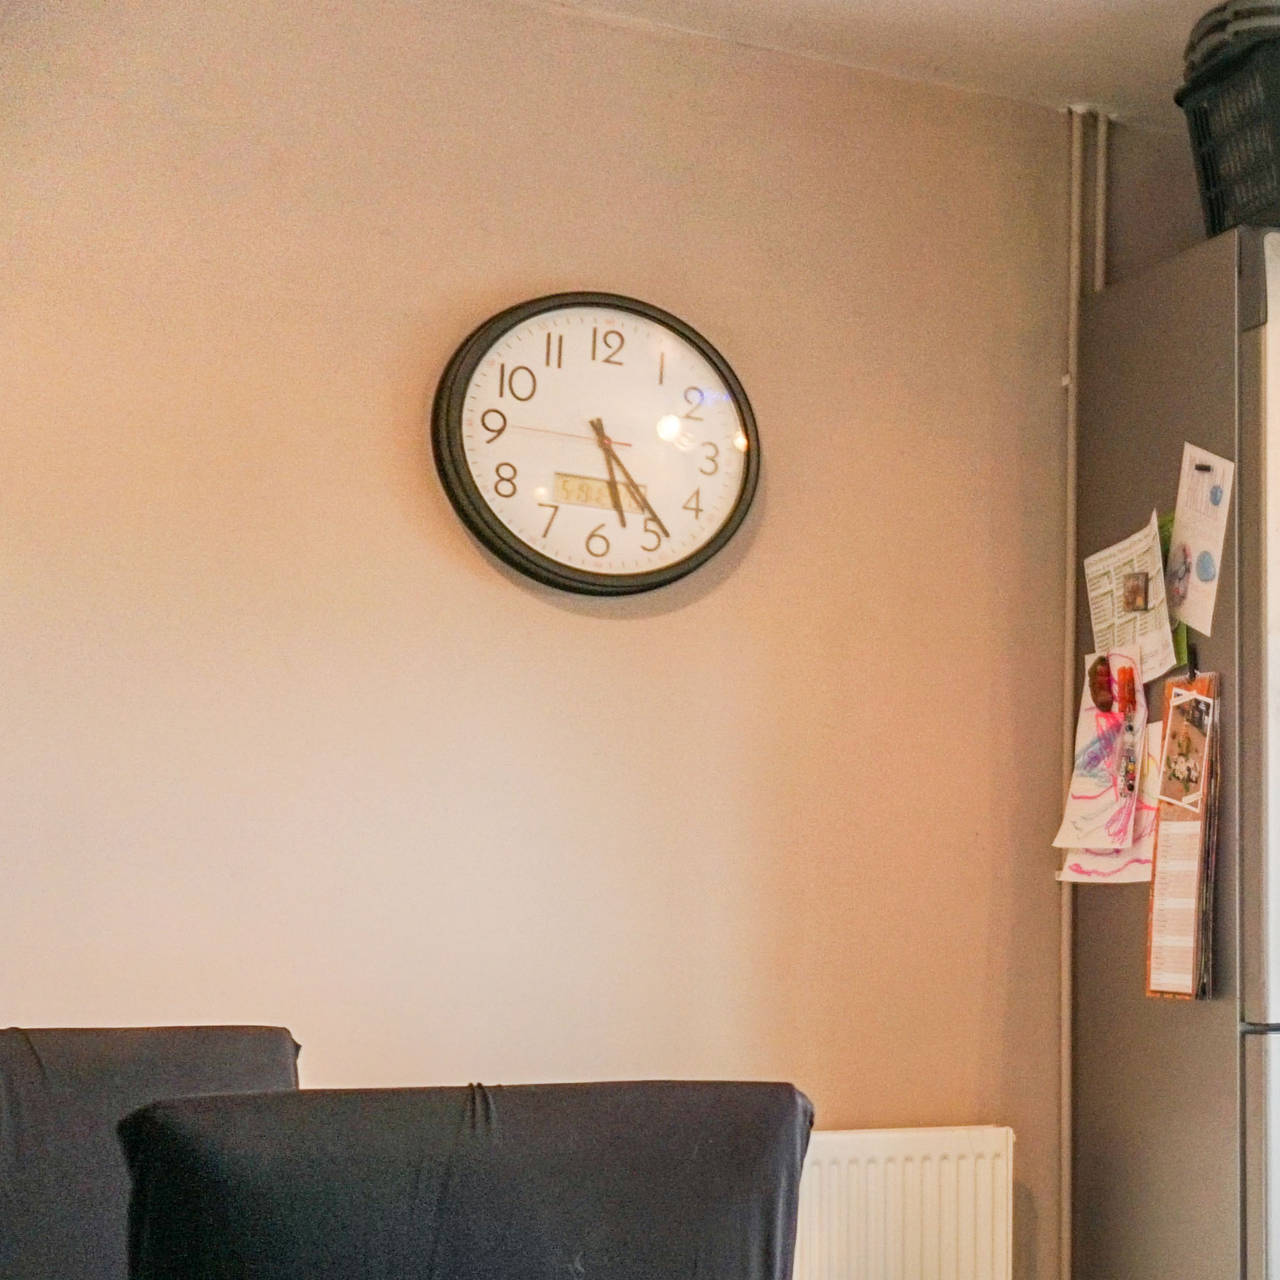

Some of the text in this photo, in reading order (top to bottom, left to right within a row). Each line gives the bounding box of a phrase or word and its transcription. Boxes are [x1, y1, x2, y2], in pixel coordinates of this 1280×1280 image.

[545, 332, 563, 369] 11
[591, 327, 625, 366] 12
[499, 362, 537, 402] 10
[658, 352, 665, 386] 1
[682, 386, 705, 422] 2
[481, 408, 507, 444] 9
[699, 441, 719, 476] 3
[494, 462, 517, 498] 8
[537, 502, 559, 538] 7
[681, 488, 704, 520] 4
[585, 523, 611, 557] 6
[640, 517, 661, 552] 5
